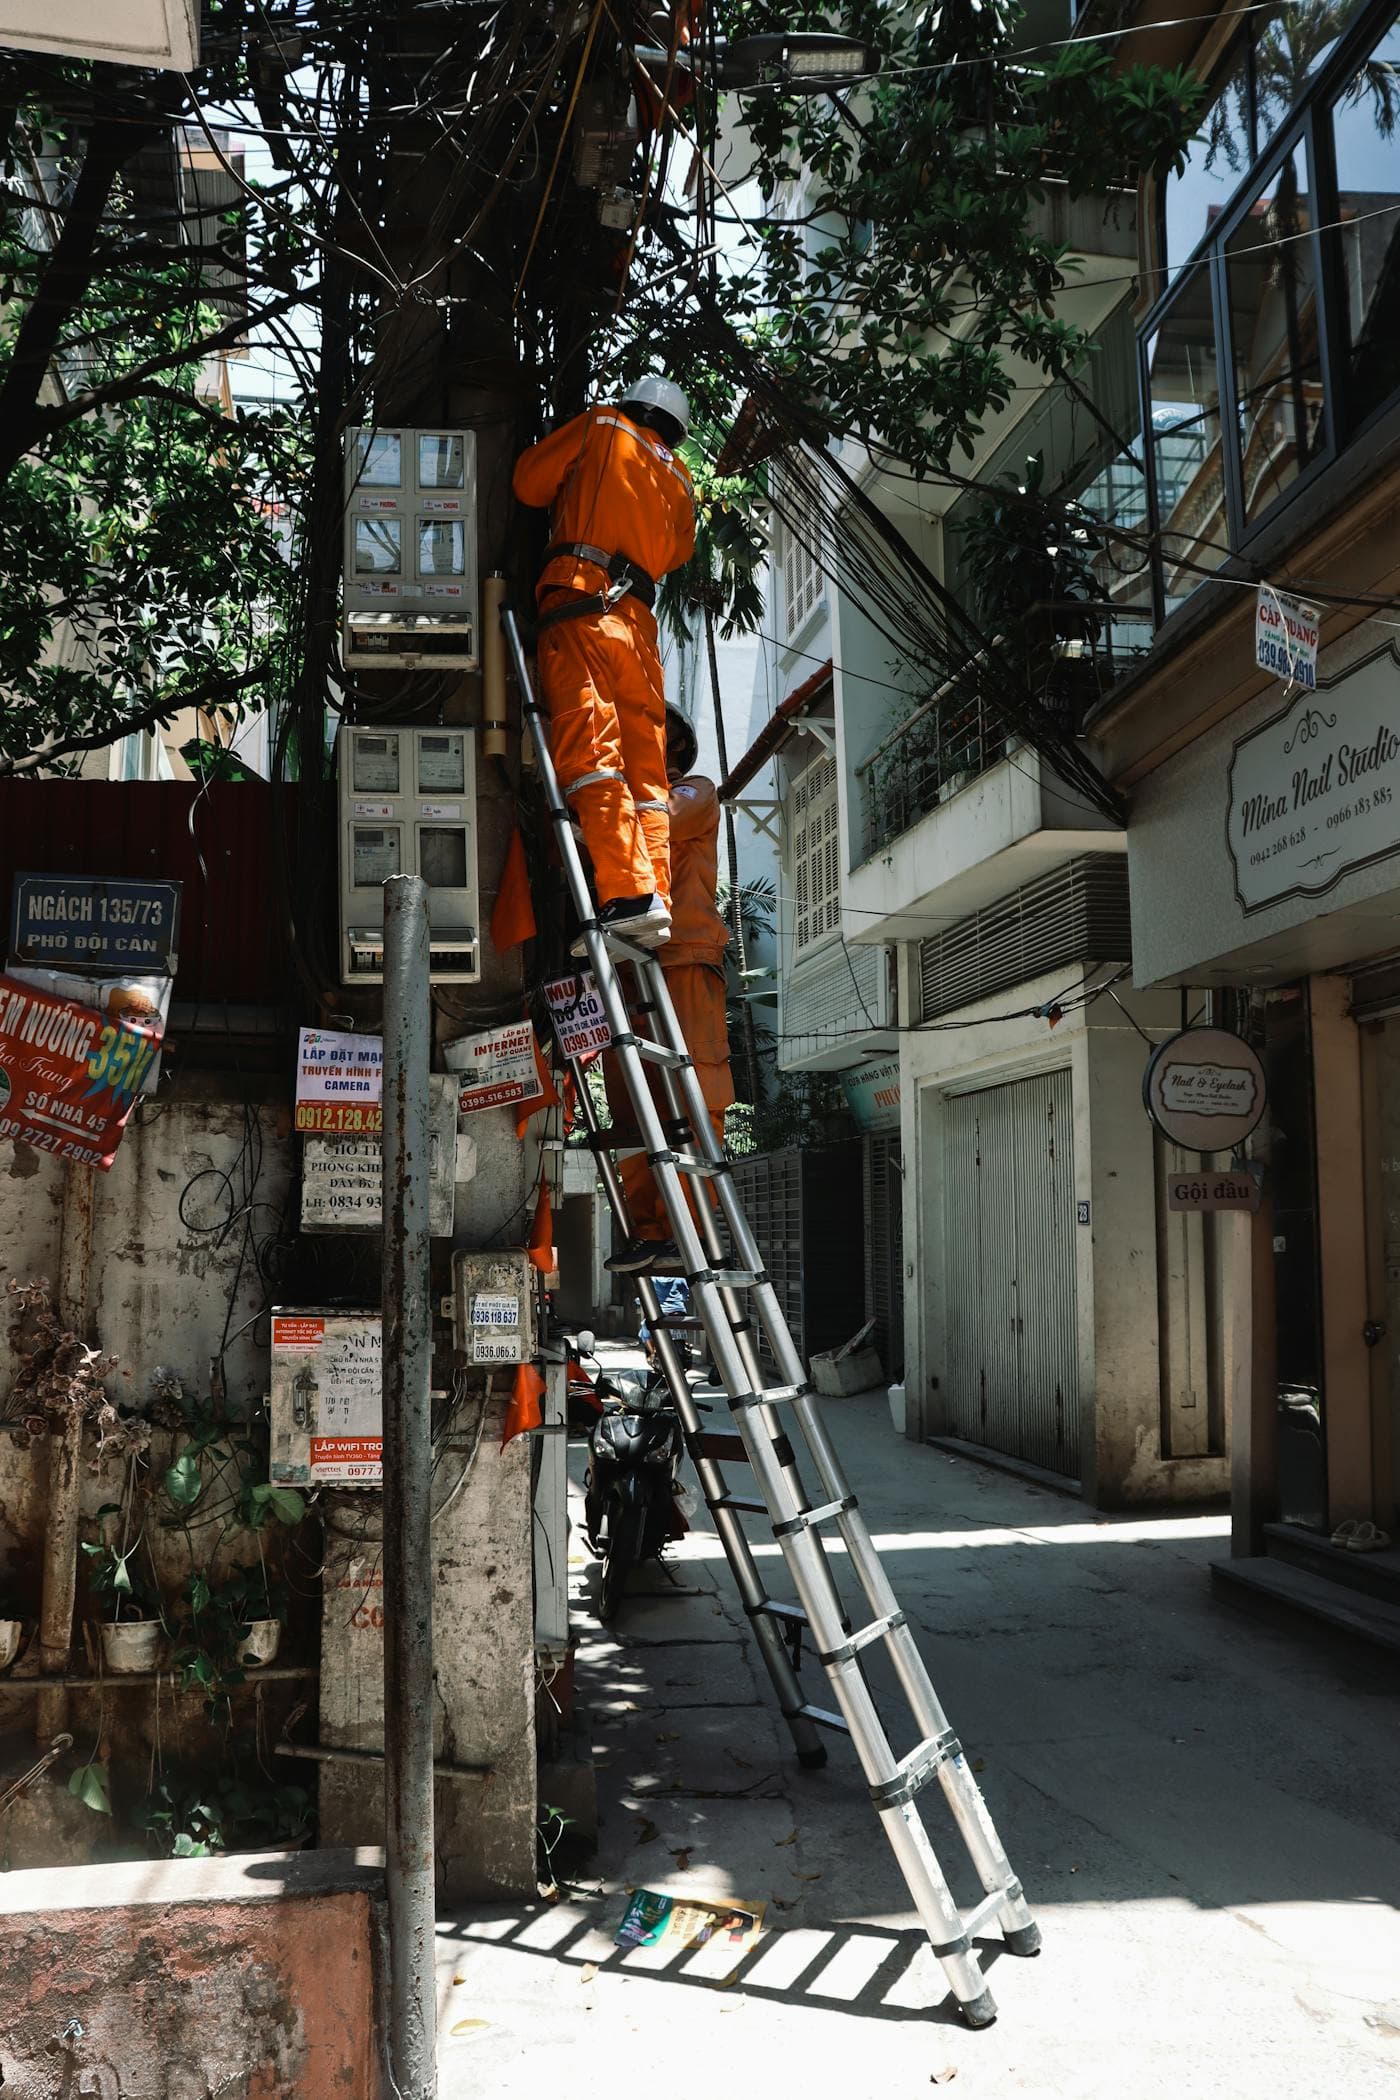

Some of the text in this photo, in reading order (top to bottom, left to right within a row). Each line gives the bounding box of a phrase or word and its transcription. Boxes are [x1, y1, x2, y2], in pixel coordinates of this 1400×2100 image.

[1260, 605, 1280, 627] CÁP
[1242, 725, 1400, 837] Mina Nail Studio
[1272, 835, 1288, 855] 268
[1290, 826, 1306, 846] 628
[1326, 808, 1351, 829] 0966
[1354, 797, 1370, 817] 183
[1373, 787, 1392, 807] 885
[28, 889, 163, 926] NGÁCH 135/73
[27, 930, 68, 949] PHỐ
[74, 932, 108, 954] ĐỘI
[579, 993, 599, 1017] GỖ
[19, 1002, 97, 1063] NƯỚNG
[563, 1026, 610, 1053] 0399.189
[303, 1046, 326, 1060] LẮP
[330, 1048, 354, 1062] ĐẶT
[474, 1035, 531, 1057] INTERNET
[19, 1056, 73, 1093] Trang
[346, 1066, 371, 1077] HÌNH
[325, 1081, 370, 1091] CAMERA
[1172, 1075, 1247, 1093] Nail & Eyelash
[461, 1087, 522, 1108] 0398.516.583
[25, 1091, 108, 1132] SỐ NHÀ 45
[20, 1127, 62, 1152] 2727
[61, 1142, 103, 1167] 2992
[305, 1198, 325, 1208] LH:
[330, 1196, 361, 1208] 0834
[1175, 1178, 1249, 1204] Gội đầu
[491, 1311, 501, 1323] 118
[504, 1311, 517, 1323] 637
[314, 1440, 335, 1451] LẮP
[337, 1443, 359, 1451] WIFI
